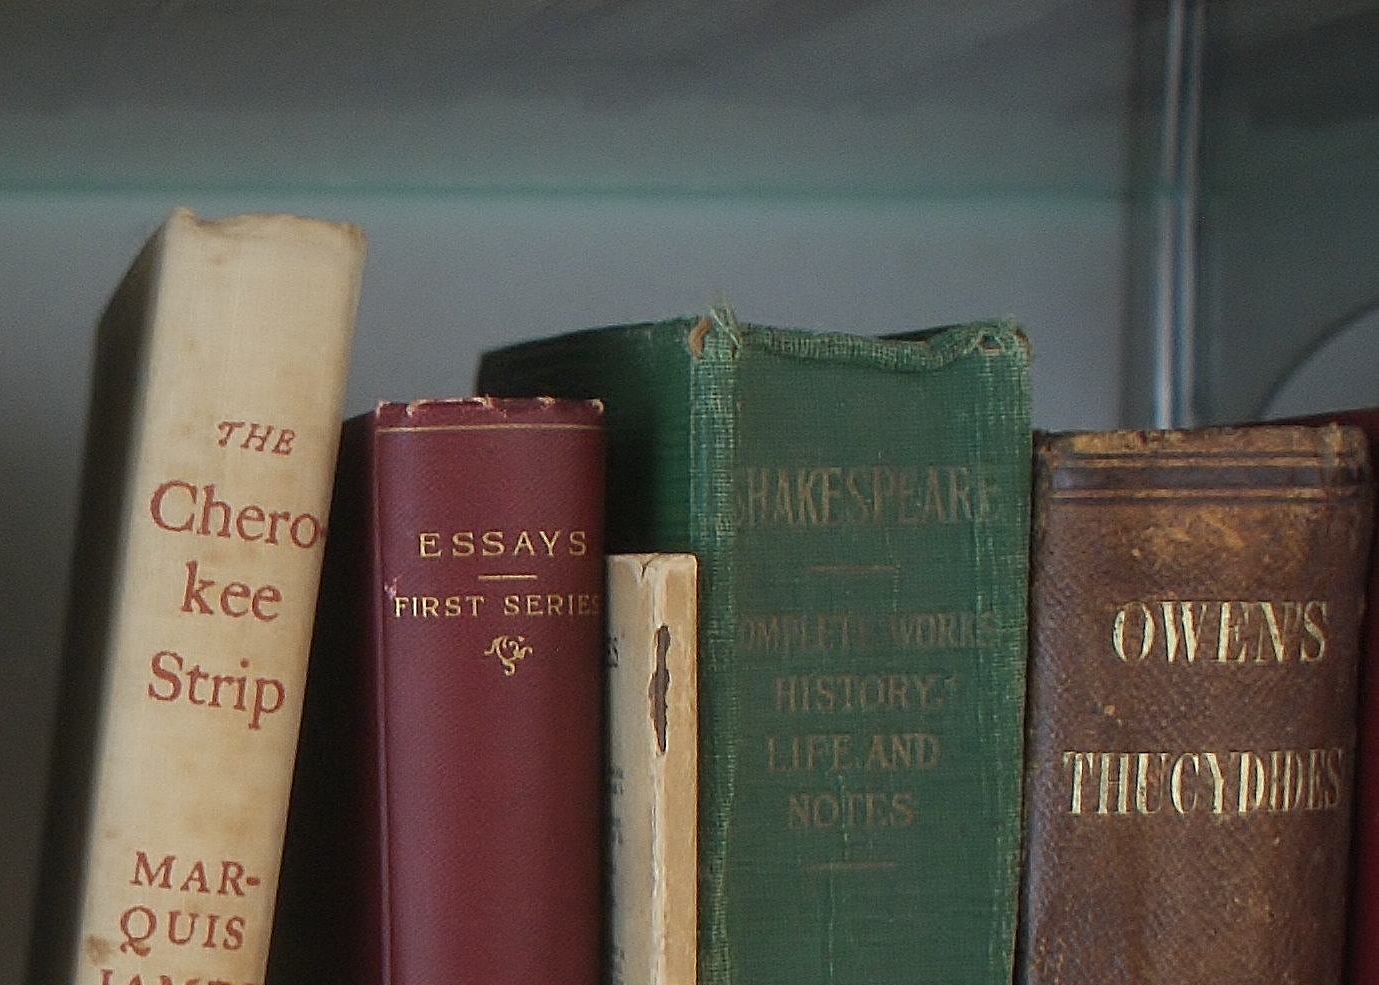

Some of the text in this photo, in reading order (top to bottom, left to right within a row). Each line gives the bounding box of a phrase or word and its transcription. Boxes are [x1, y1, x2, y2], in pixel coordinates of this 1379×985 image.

[217, 421, 297, 455] THE
[418, 530, 587, 557] ESSAYS
[181, 560, 283, 622] kee
[393, 595, 485, 618] FIRST
[147, 650, 286, 731] Strip
[767, 731, 940, 771] LIFE AND
[1063, 750, 1342, 815] THUCYDIDES
[787, 792, 916, 829] NOTES
[129, 851, 262, 896] MAR-
[120, 905, 246, 957] QUIS
